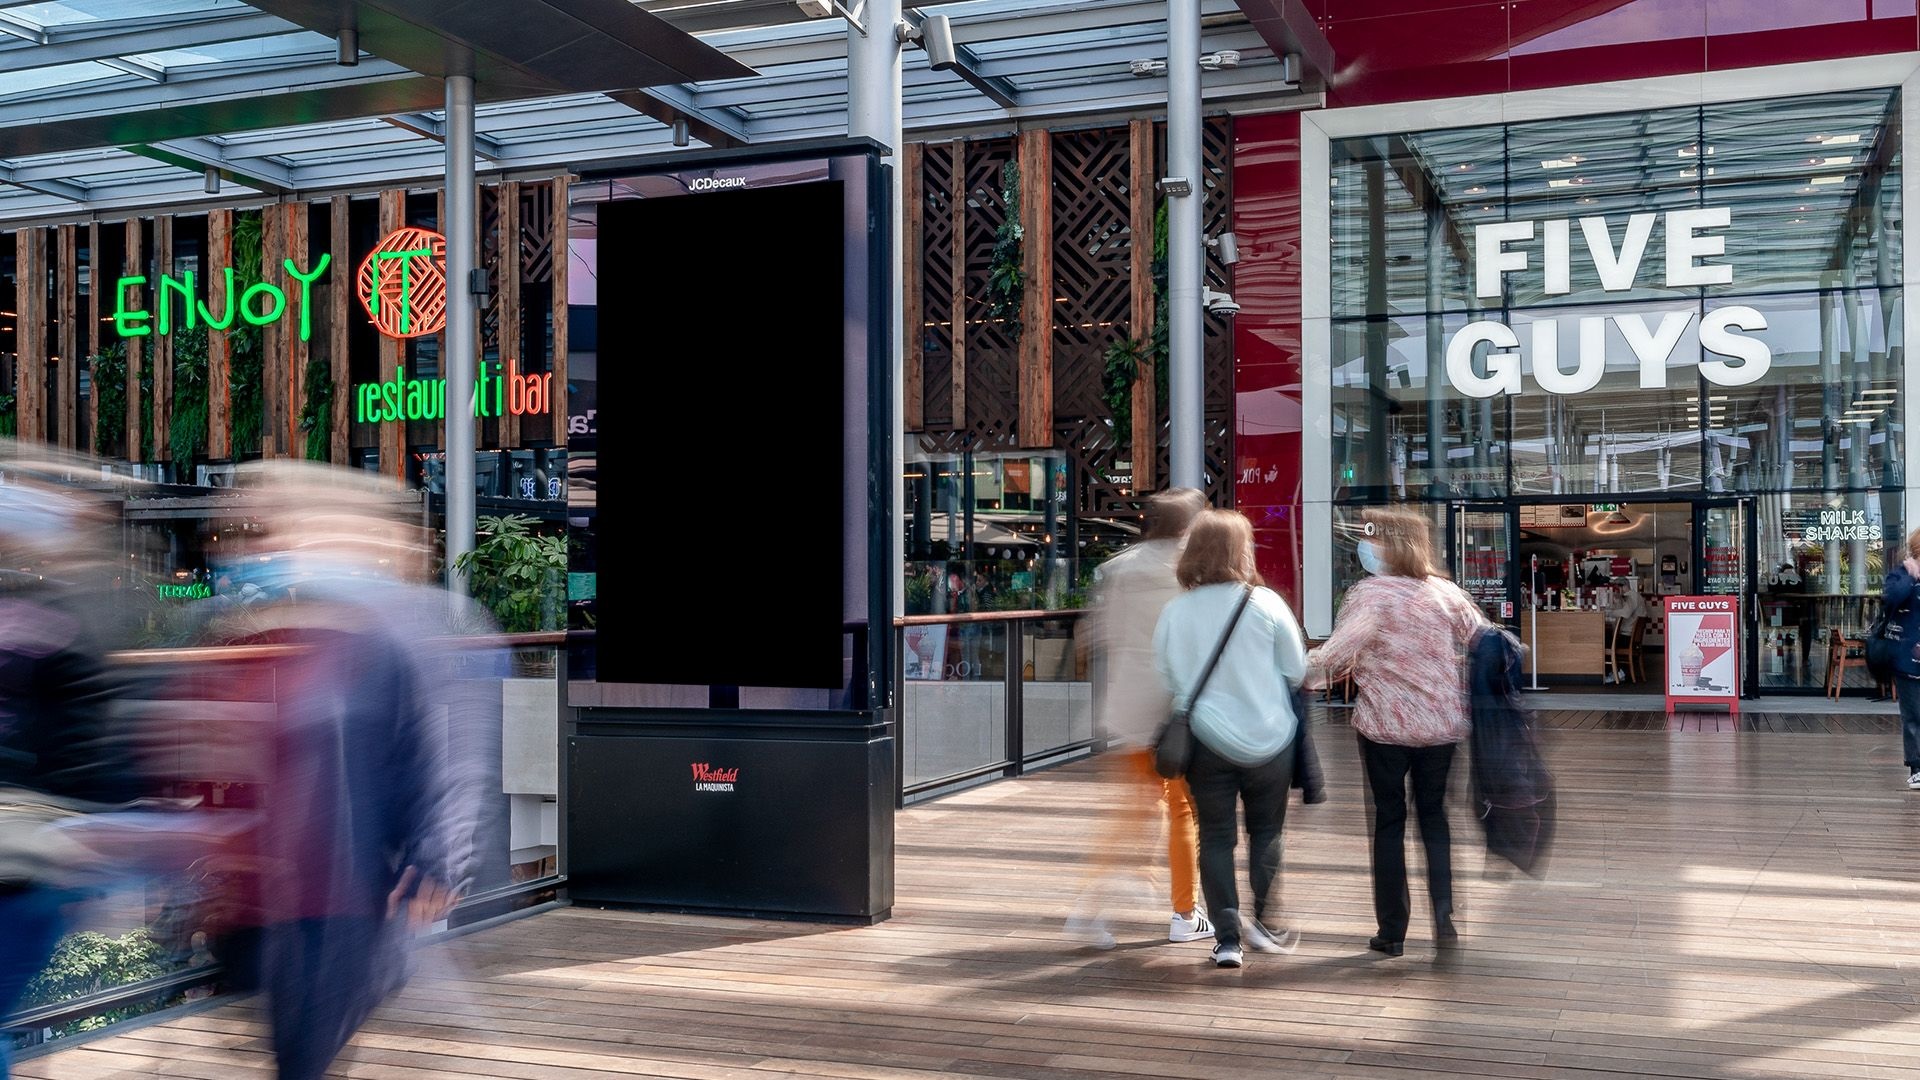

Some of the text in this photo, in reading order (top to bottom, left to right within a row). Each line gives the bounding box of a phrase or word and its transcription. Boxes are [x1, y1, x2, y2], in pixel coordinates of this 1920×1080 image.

[689, 177, 746, 190] JCDecaux
[1475, 207, 1733, 298] FIVE
[113, 247, 433, 342] ENJOY IT
[1445, 305, 1772, 399] GUYS
[358, 361, 490, 423] restaurt
[509, 358, 552, 415] bar
[1820, 510, 1865, 525] MILK
[1805, 526, 1881, 541] SHAKES
[1671, 601, 1730, 610] FIVE GUYS
[691, 763, 739, 781] Westfield
[696, 783, 734, 791] LA MAQUINISTA
